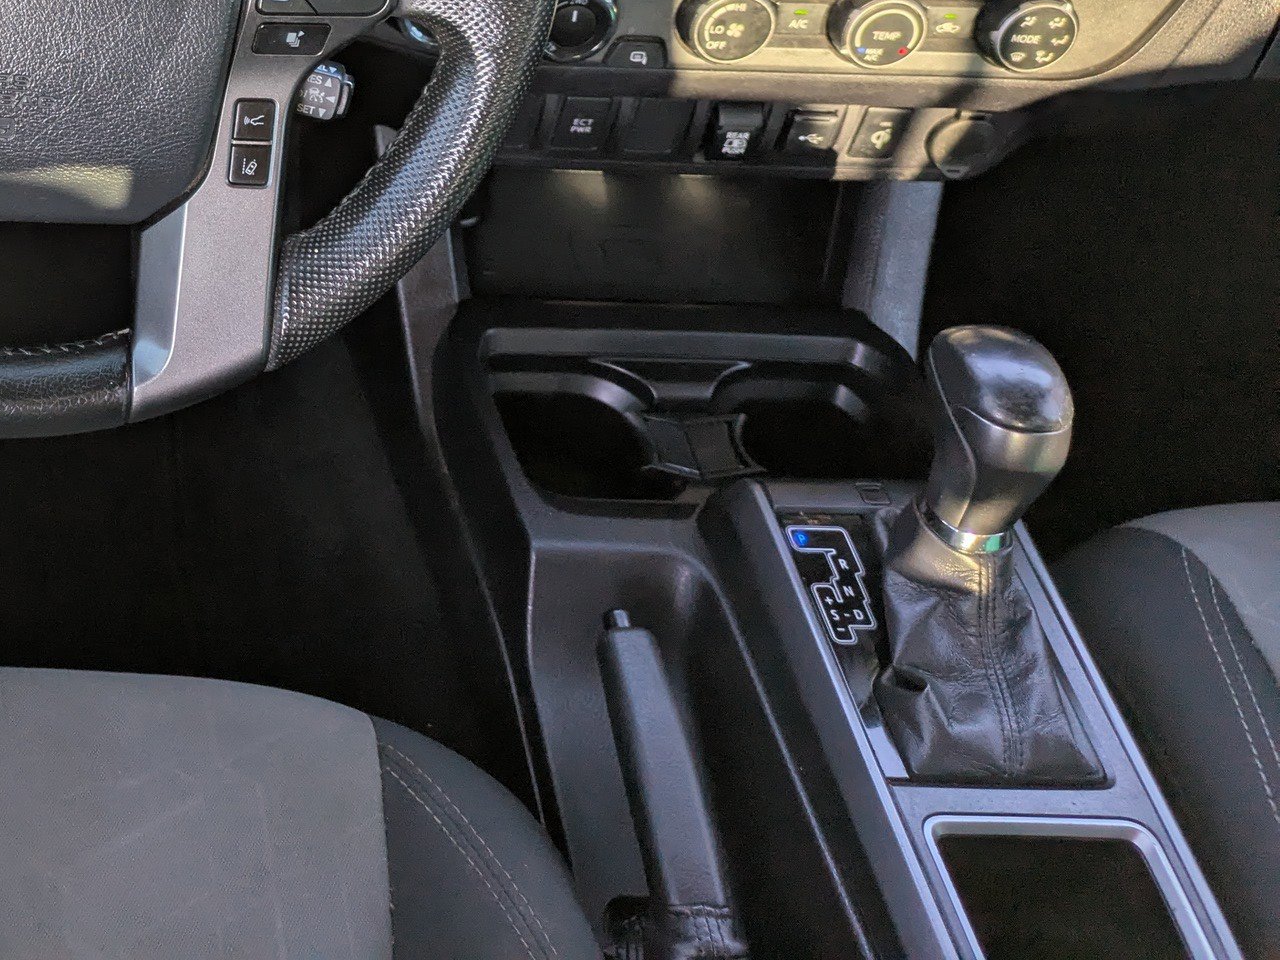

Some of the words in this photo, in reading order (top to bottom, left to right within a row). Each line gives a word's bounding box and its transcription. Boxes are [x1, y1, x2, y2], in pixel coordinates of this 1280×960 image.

[789, 19, 808, 29] A/C
[709, 26, 724, 35] LO
[873, 31, 901, 41] TEMP
[1011, 35, 1042, 45] MODE
[705, 40, 727, 51] OFF
[297, 103, 316, 115] SET
[573, 118, 594, 127] ECT
[570, 126, 592, 134] PWR
[726, 131, 750, 140] REAR
[838, 559, 849, 570] R
[842, 586, 855, 597] N
[830, 610, 840, 620] S
[853, 609, 864, 620] D
